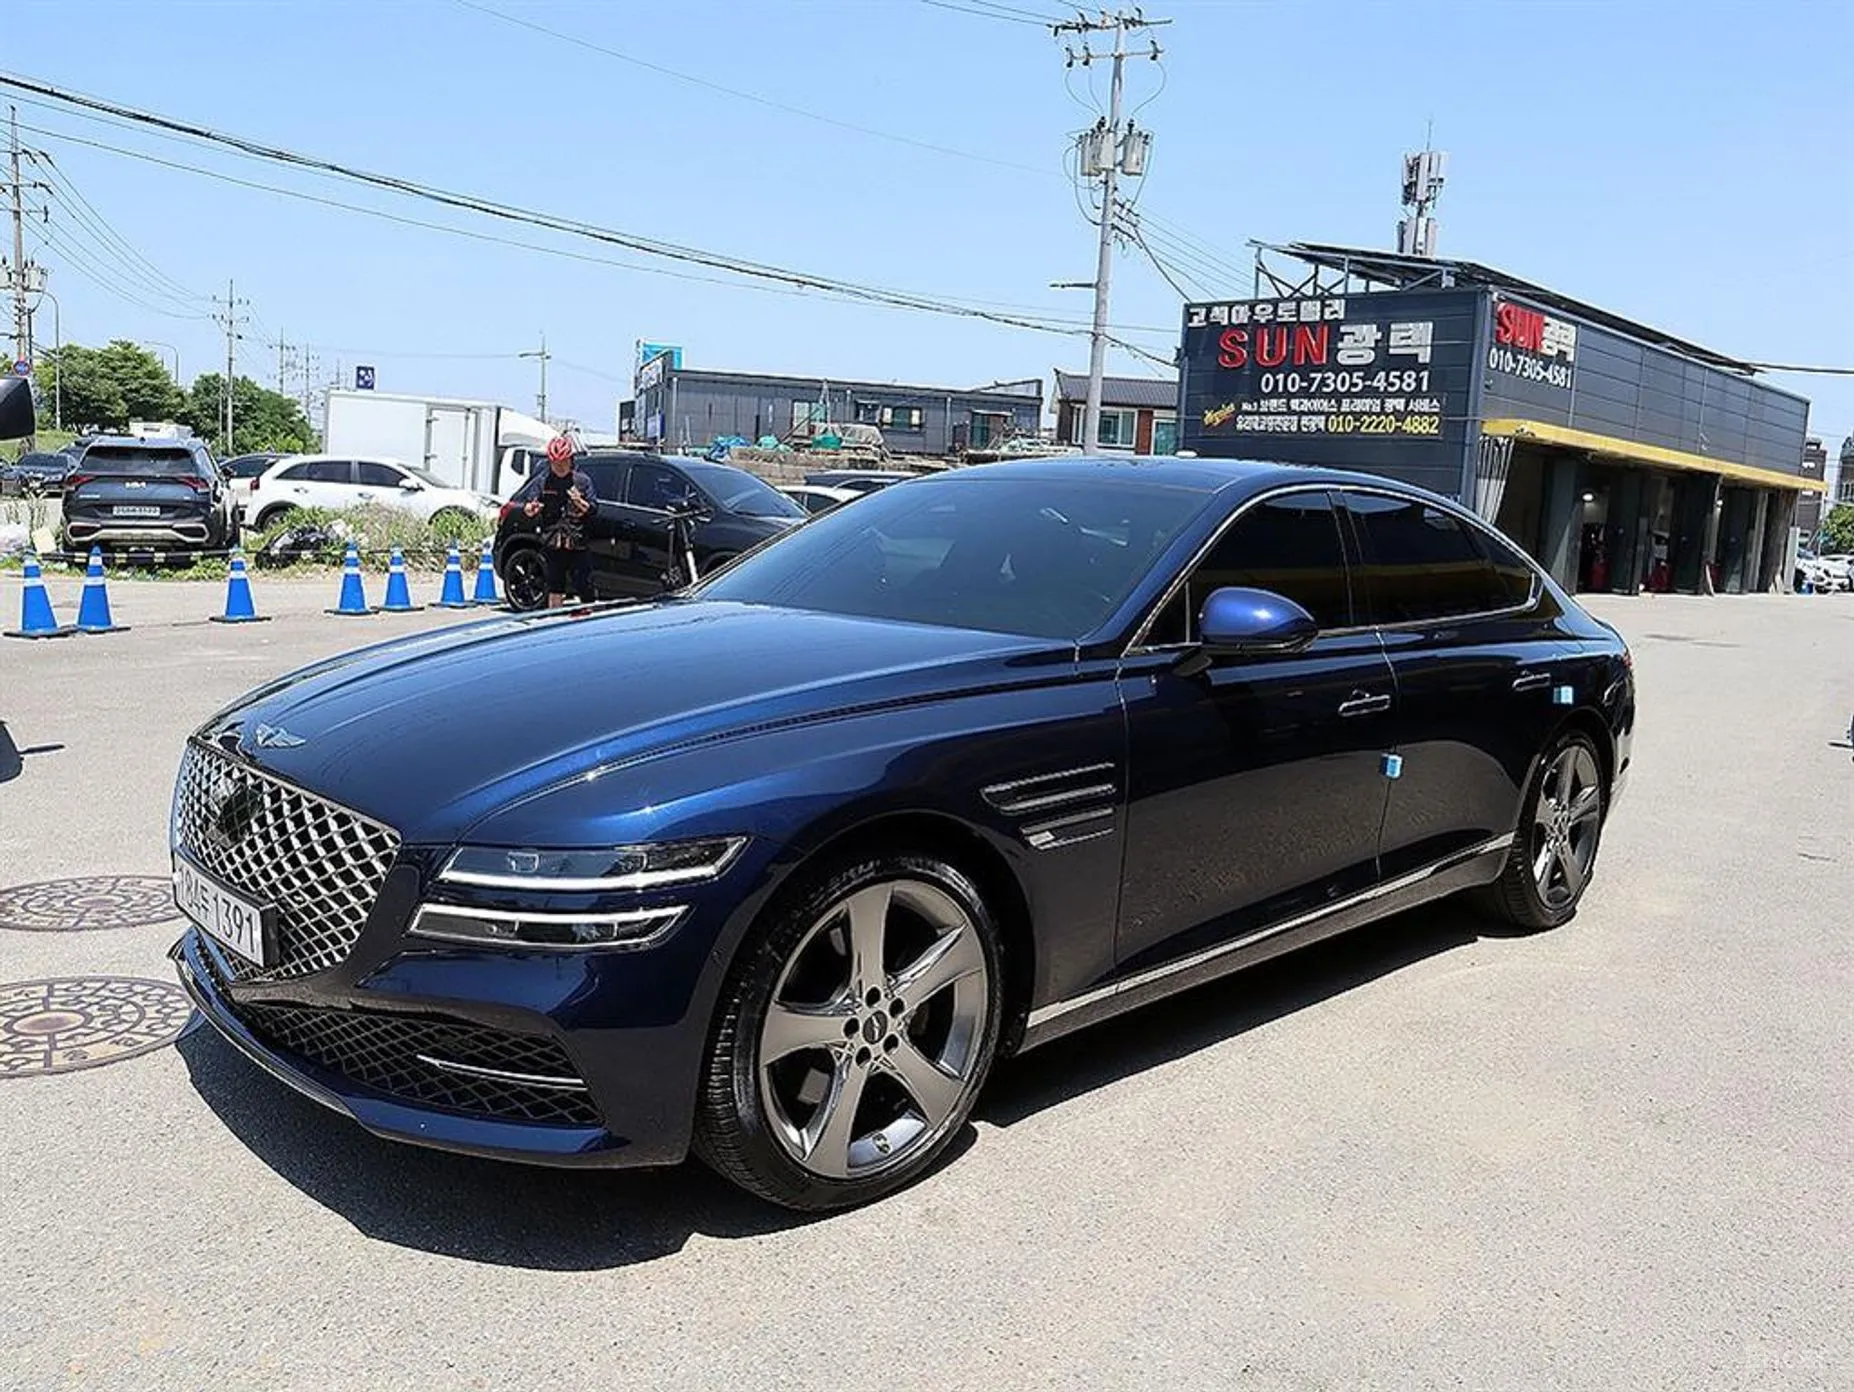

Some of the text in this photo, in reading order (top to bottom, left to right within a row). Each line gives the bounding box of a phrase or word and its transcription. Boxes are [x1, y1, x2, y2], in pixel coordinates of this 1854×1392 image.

[1217, 320, 1433, 369] SUN광택
[1260, 371, 1430, 393] 010-7305-4581
[1489, 347, 1572, 389] 010-7305-4581
[1327, 414, 1439, 434] 010-2220-4882
